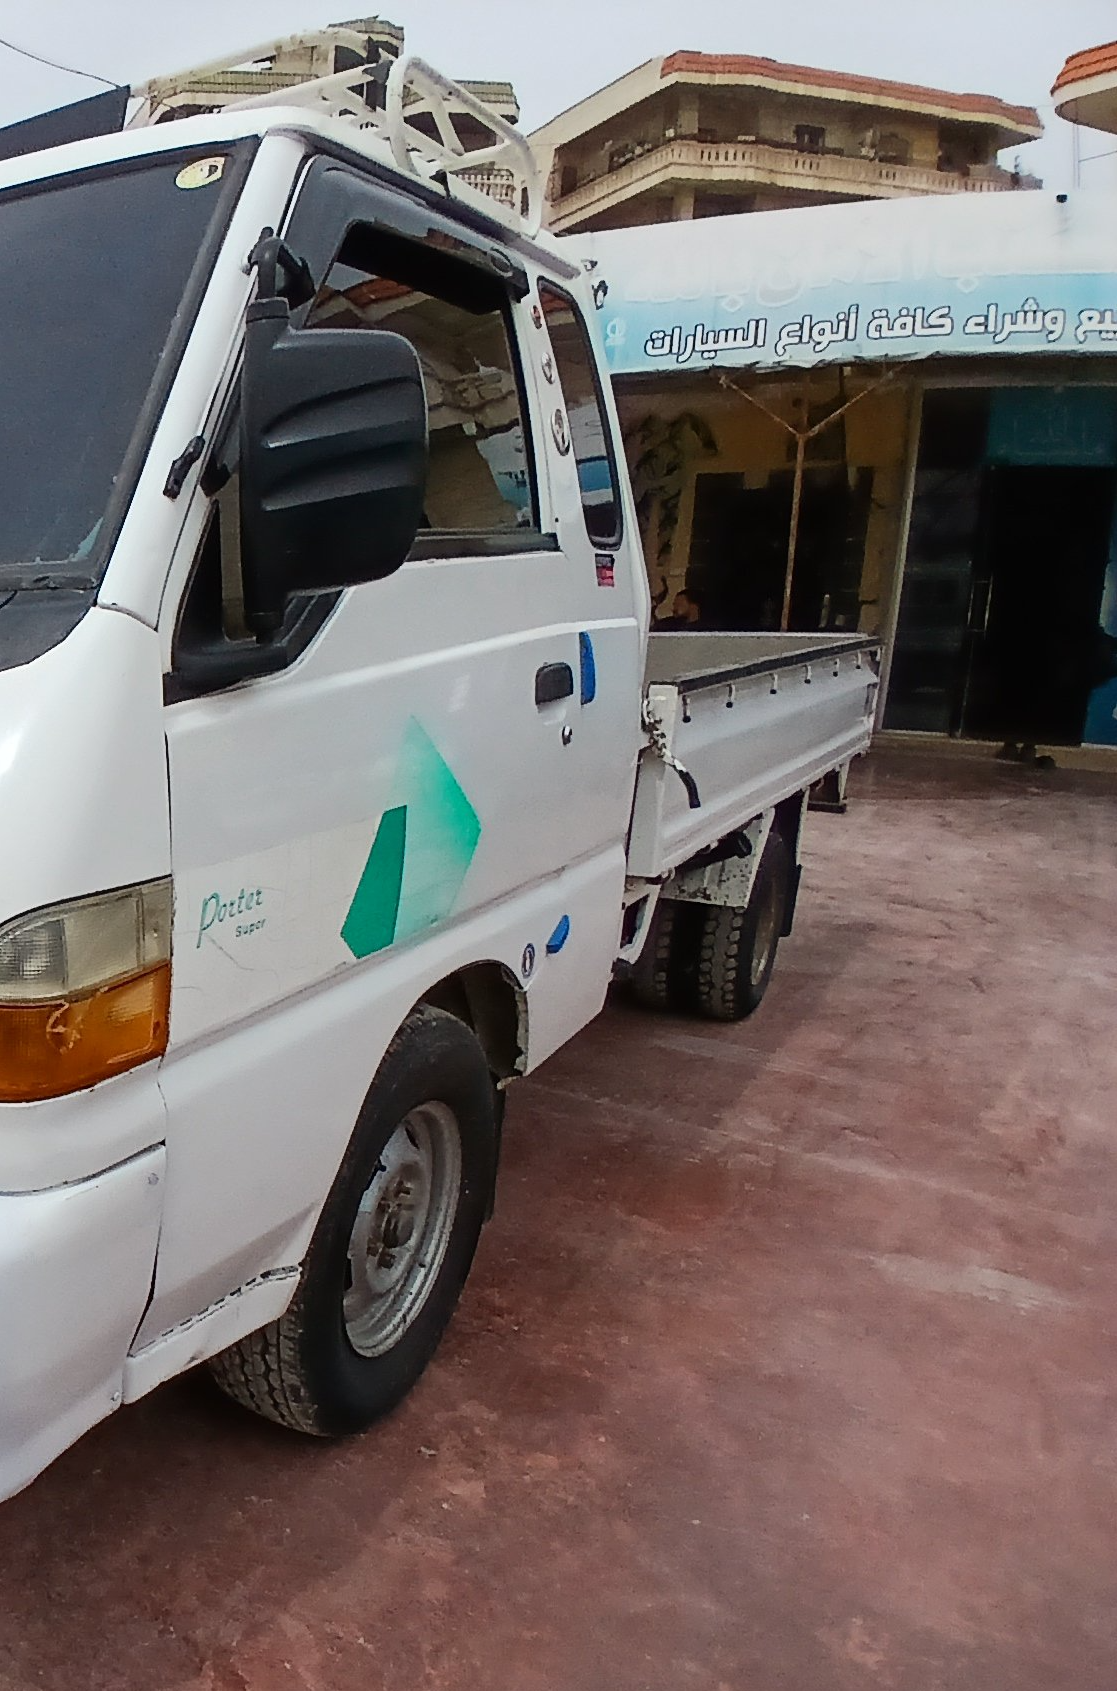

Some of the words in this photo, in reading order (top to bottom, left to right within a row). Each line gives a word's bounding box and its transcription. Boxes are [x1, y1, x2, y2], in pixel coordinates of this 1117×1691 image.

[644, 318, 767, 363] السيارات
[775, 304, 860, 355] أنواع
[867, 305, 954, 340] كافة
[964, 297, 1066, 344] وشراء
[1075, 308, 1117, 344] يع
